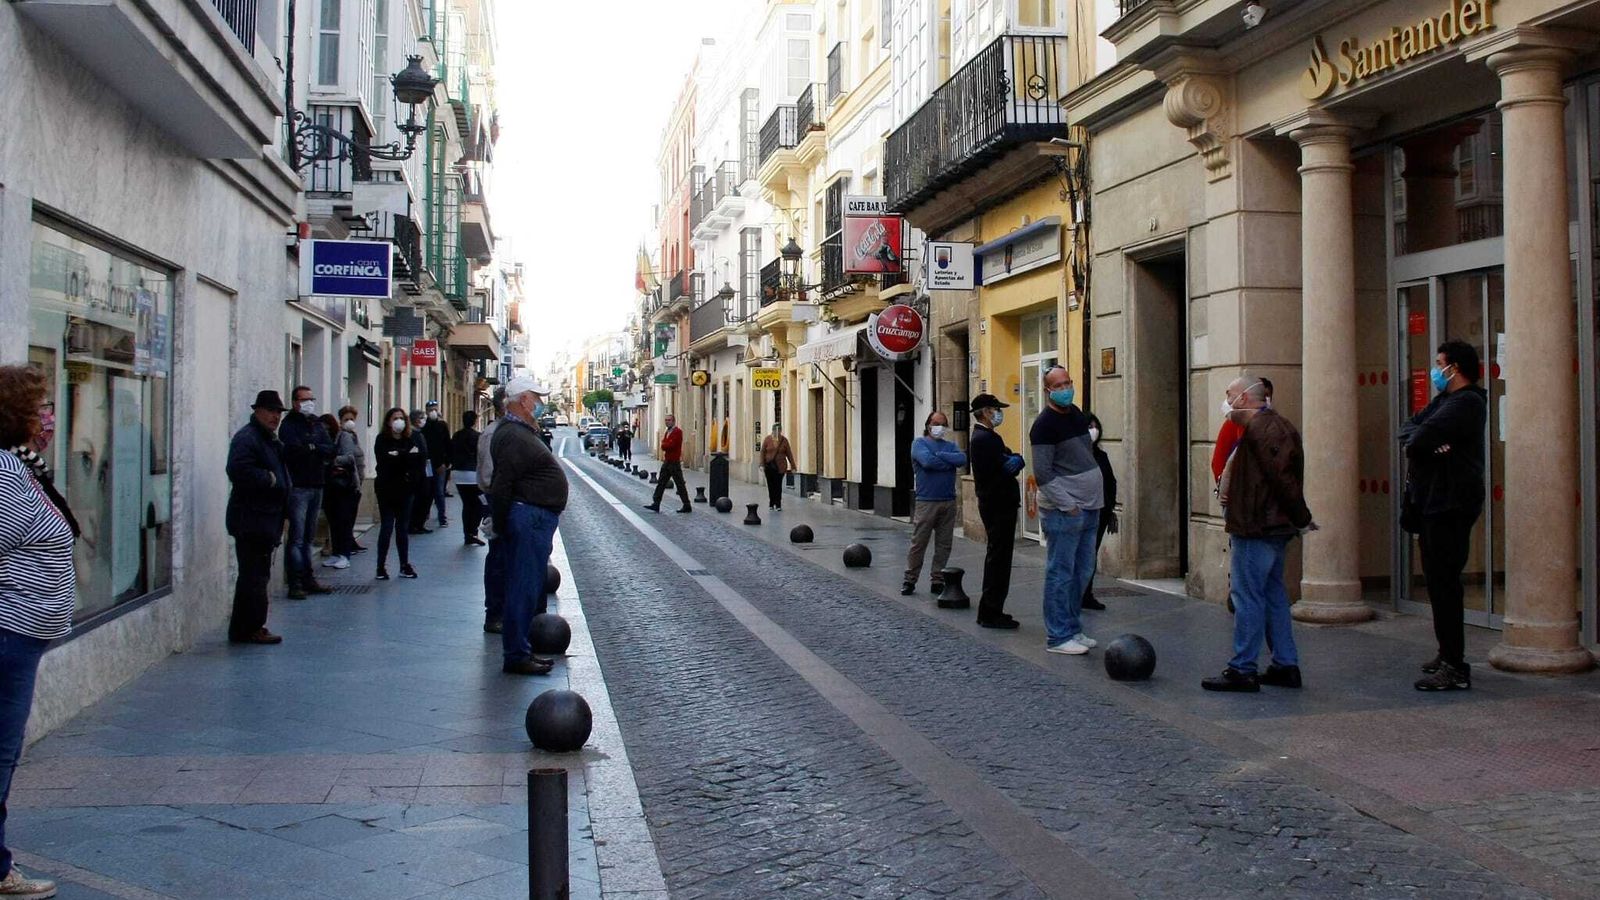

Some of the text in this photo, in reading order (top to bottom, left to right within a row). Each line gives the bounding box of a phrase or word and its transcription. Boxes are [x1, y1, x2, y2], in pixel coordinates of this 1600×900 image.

[1338, 0, 1496, 87] Santander
[848, 201, 865, 212] CAFE
[866, 201, 880, 212] BAR
[877, 325, 920, 339] Cruzcampo
[412, 347, 435, 356] GAES
[754, 378, 780, 388] ORO
